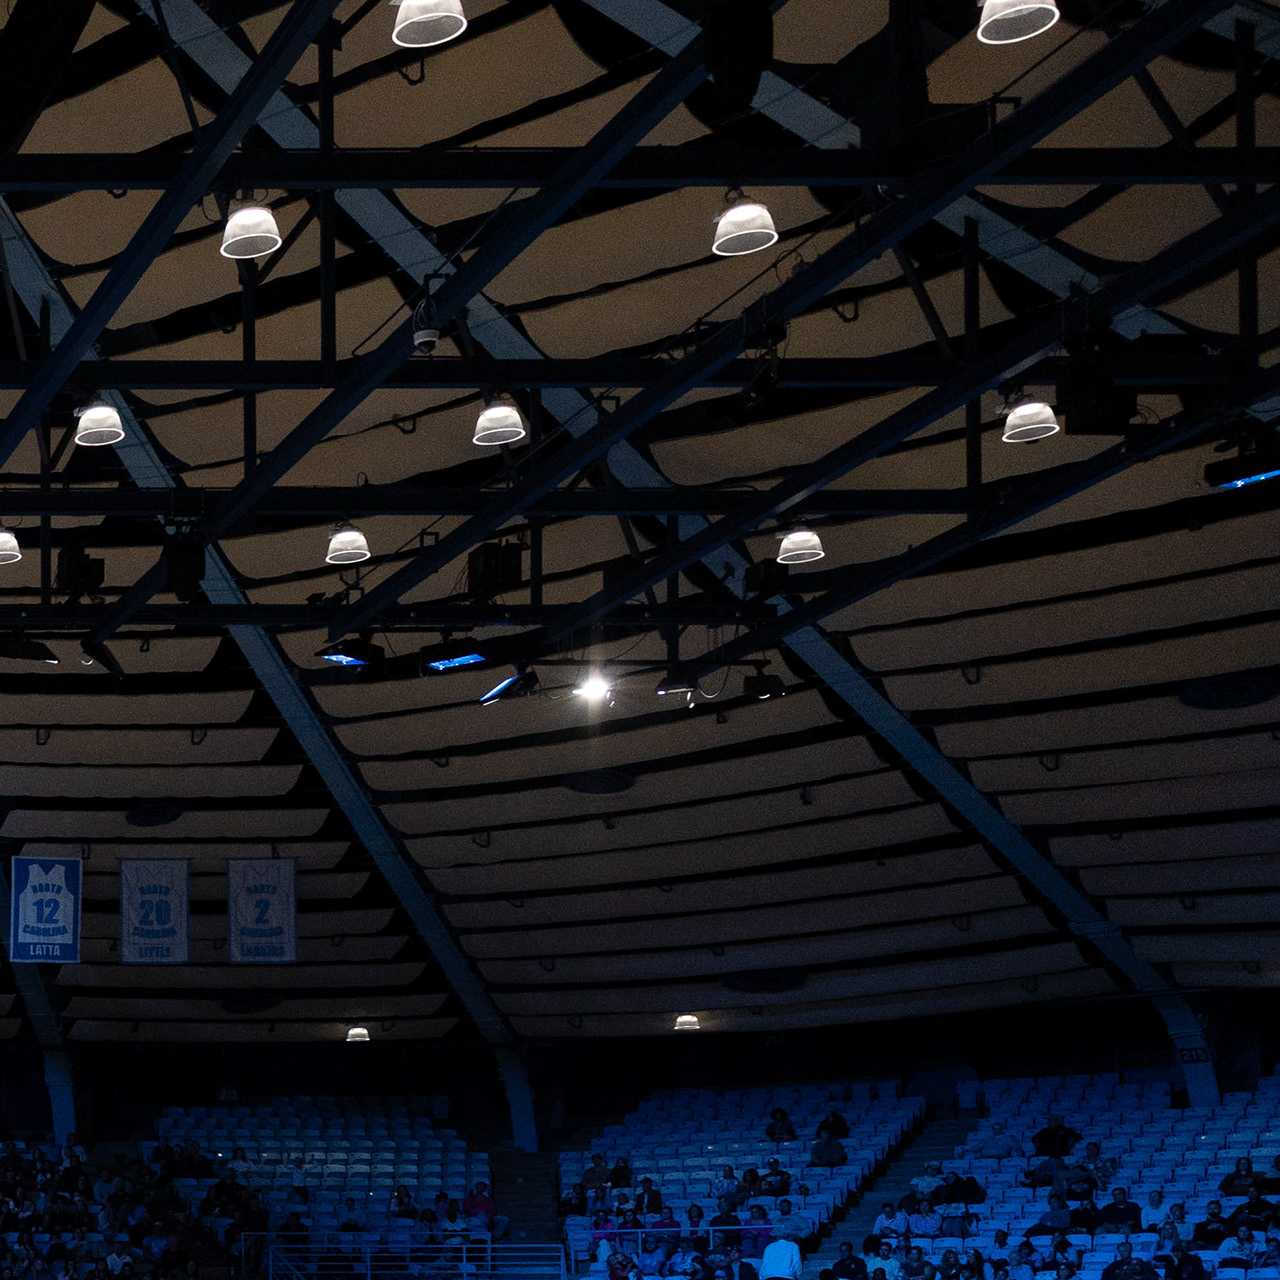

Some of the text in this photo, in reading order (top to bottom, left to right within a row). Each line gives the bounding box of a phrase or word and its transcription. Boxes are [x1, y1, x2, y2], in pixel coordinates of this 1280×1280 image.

[31, 883, 63, 895] NORTH
[32, 899, 60, 925] 12
[254, 899, 270, 925] 2
[22, 925, 69, 937] CAROLINA
[29, 944, 61, 956] LATTA
